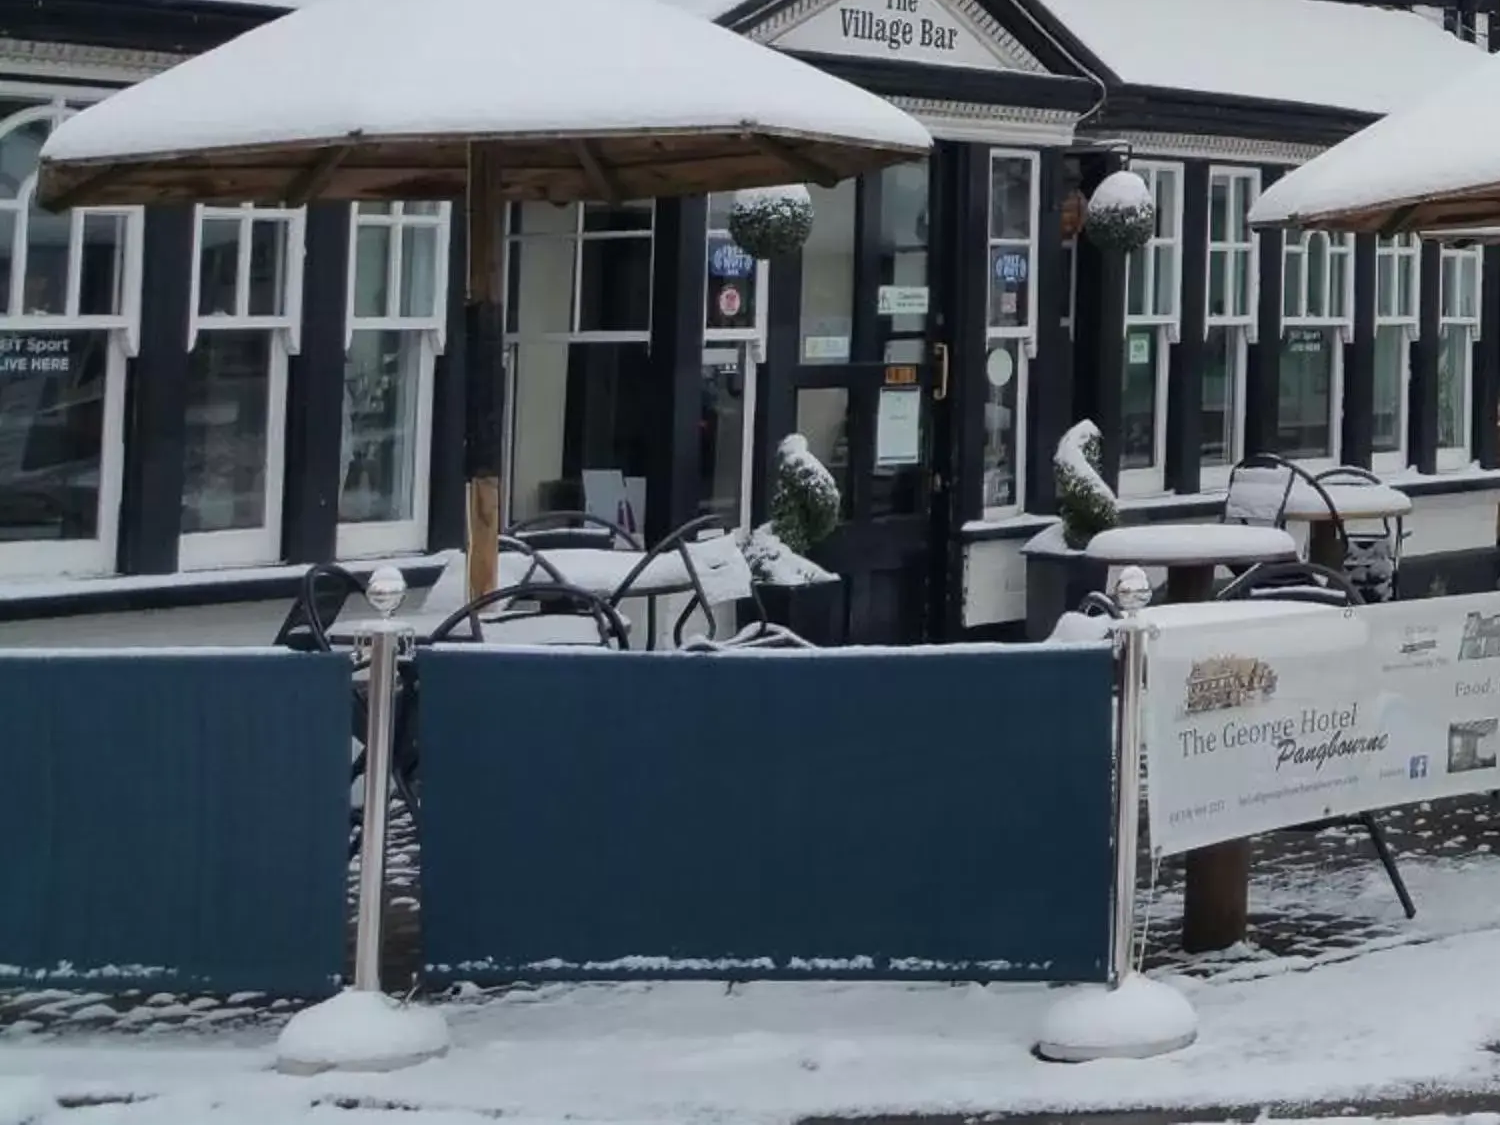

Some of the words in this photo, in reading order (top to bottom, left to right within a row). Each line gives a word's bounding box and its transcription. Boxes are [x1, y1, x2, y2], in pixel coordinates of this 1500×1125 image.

[840, 8, 913, 50] Village
[920, 18, 958, 50] Bar
[27, 337, 70, 354] Sport
[31, 357, 69, 371] HERE
[1178, 727, 1217, 759] The
[1222, 722, 1295, 750] George
[1300, 701, 1358, 735] Hotel
[1275, 730, 1389, 771] Pangbourne
